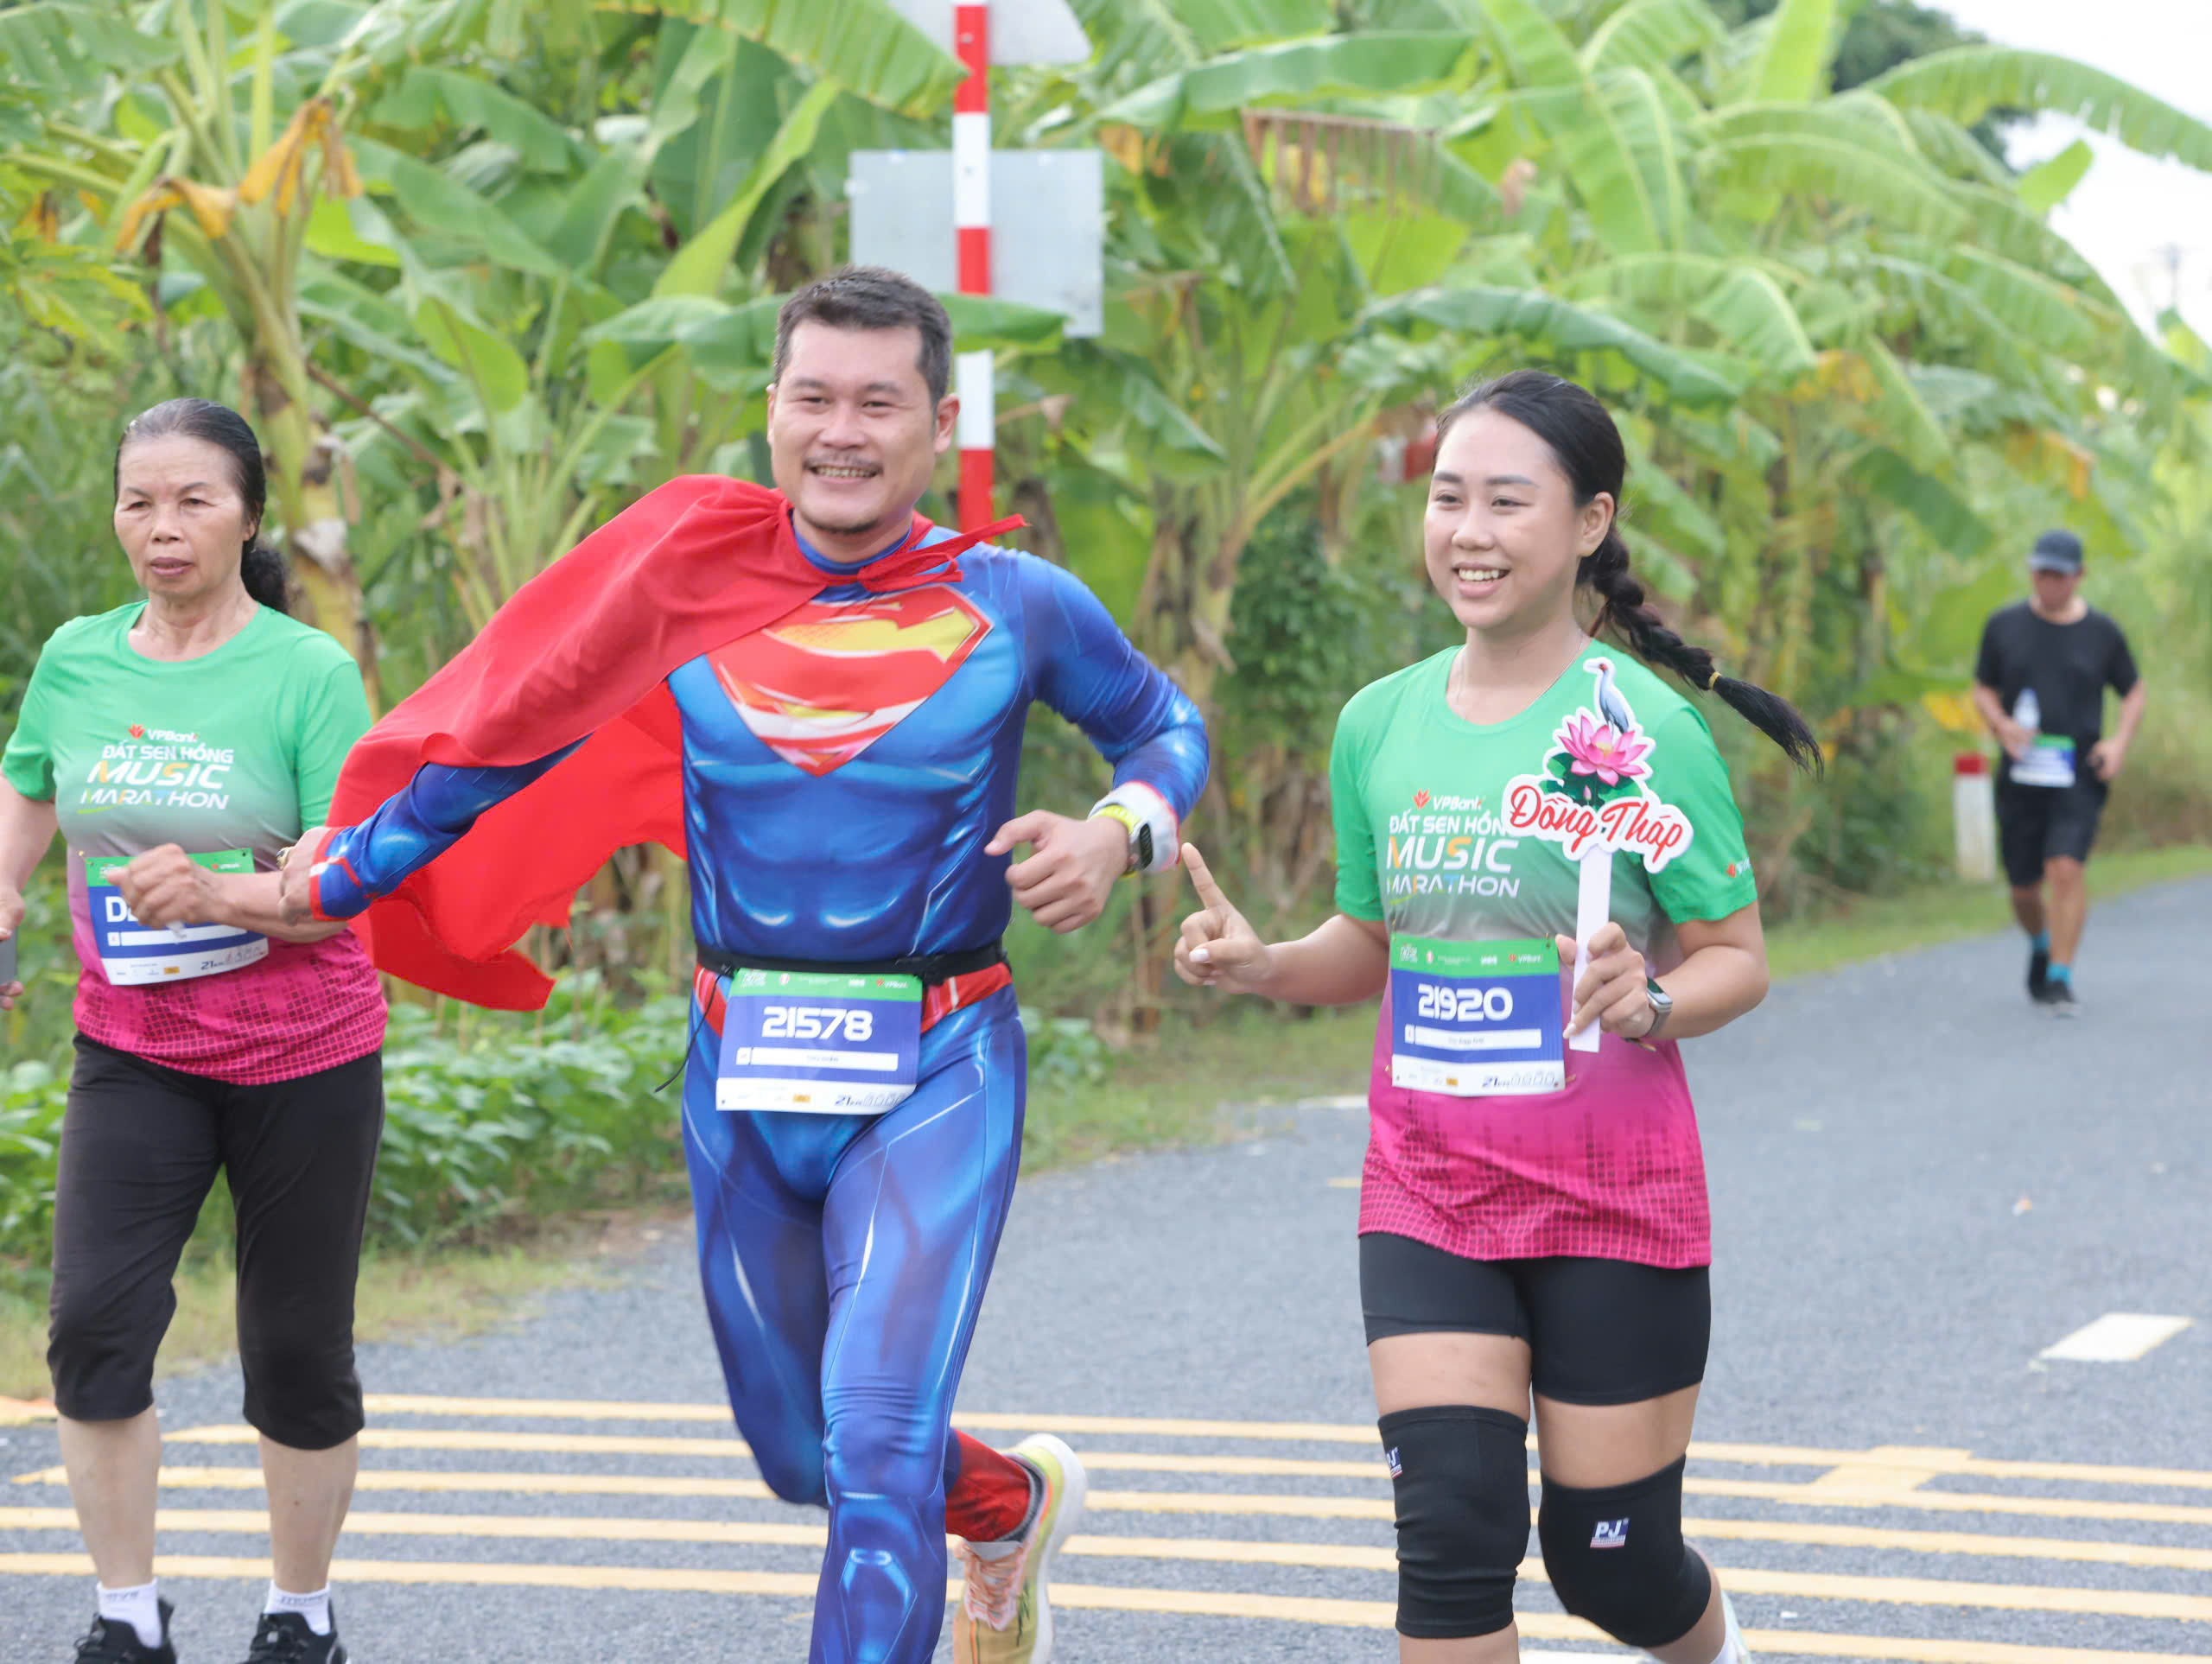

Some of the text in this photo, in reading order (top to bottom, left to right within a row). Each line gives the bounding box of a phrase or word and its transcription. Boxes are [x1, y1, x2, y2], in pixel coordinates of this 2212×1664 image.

[140, 745, 176, 761] SEN
[86, 760, 231, 790] MUSIC
[79, 788, 230, 810] MARATHON
[1433, 795, 1484, 811] VPBank
[1422, 815, 1461, 835] SEN
[1510, 784, 1683, 863] Đồng Tháp
[1386, 835, 1520, 873] MUSIC
[1386, 873, 1521, 899] MARATHON
[1418, 983, 1514, 1022] 21920
[761, 1006, 874, 1042] 21578
[1594, 1519, 1623, 1539] PJ
